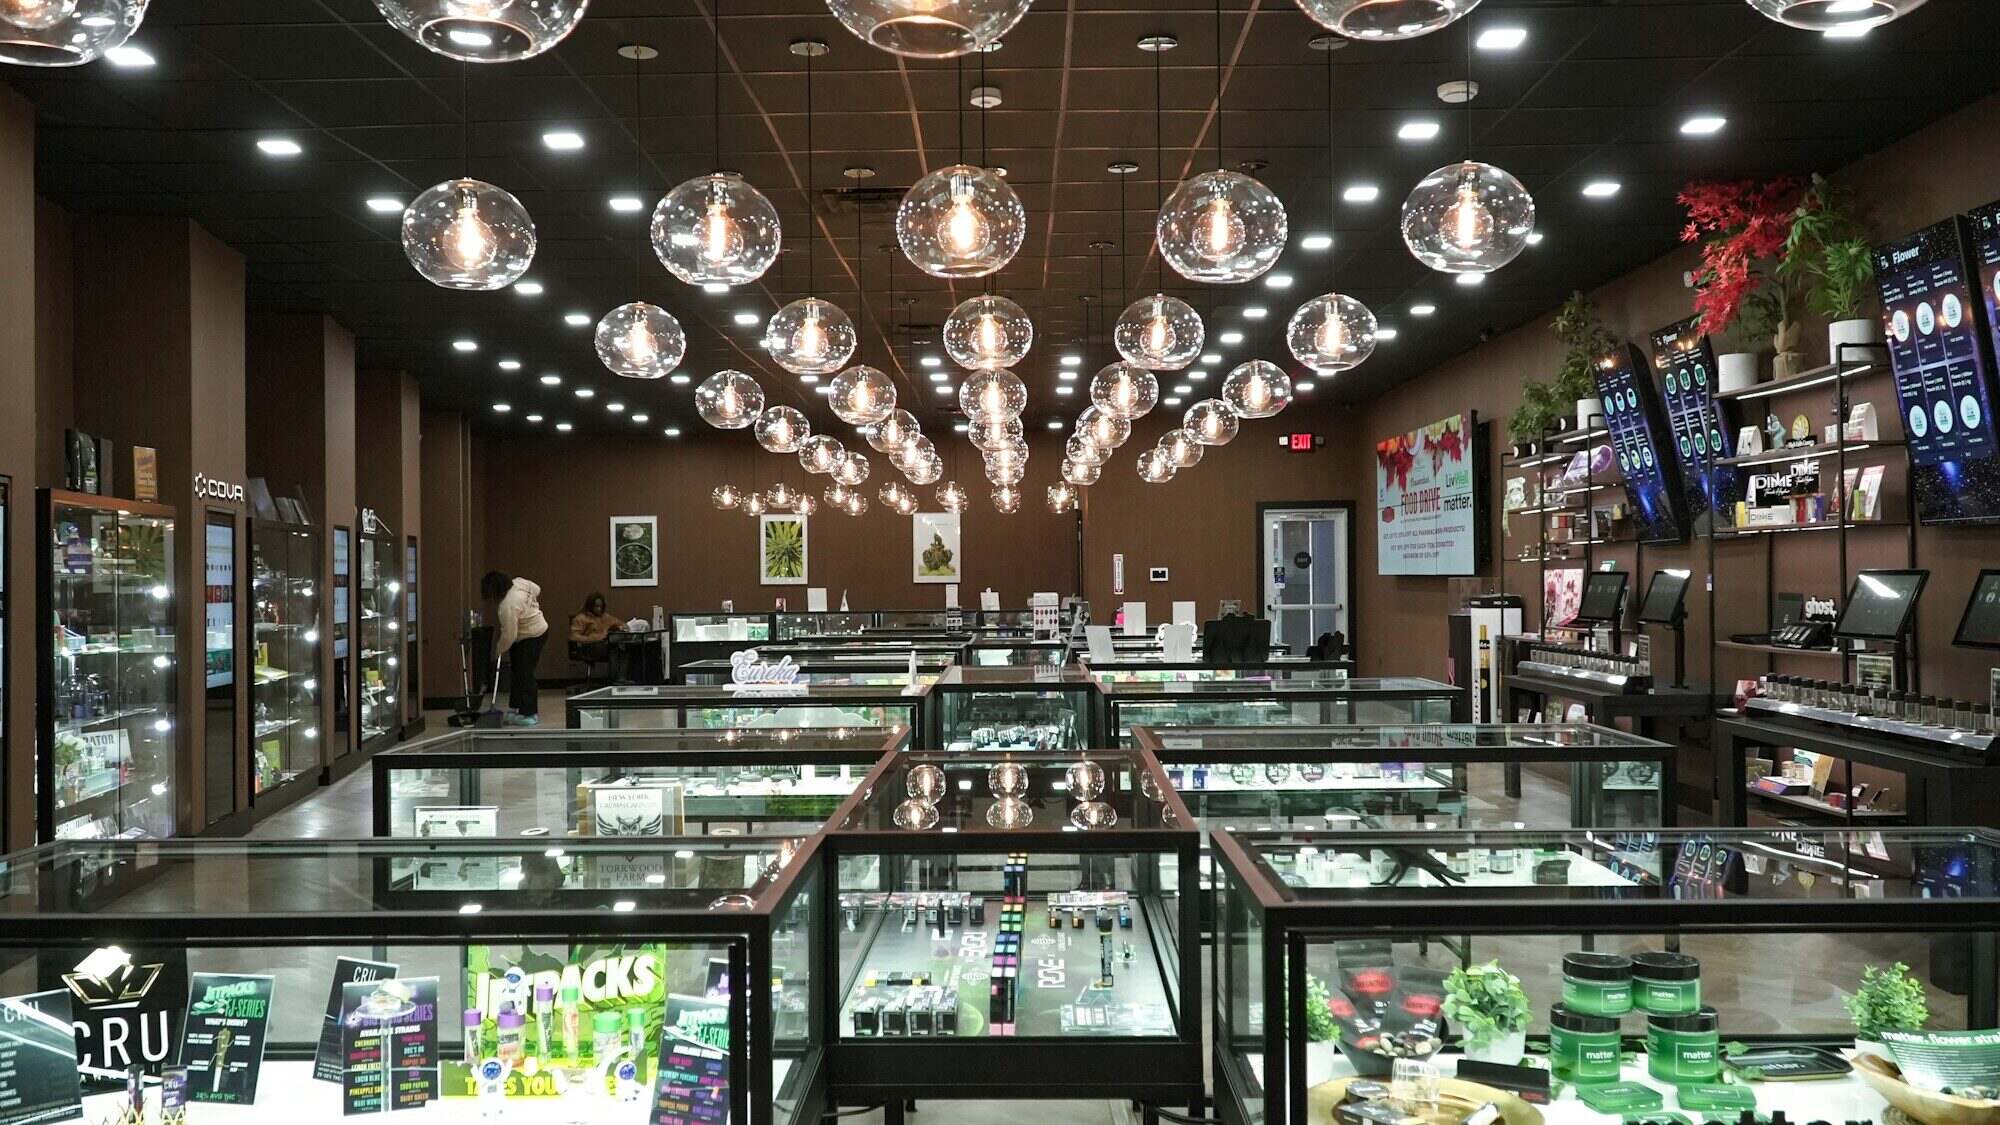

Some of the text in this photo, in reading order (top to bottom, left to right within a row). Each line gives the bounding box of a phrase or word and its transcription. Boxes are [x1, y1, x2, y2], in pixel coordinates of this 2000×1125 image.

[1892, 246, 1920, 264] Flower
[1291, 433, 1312, 450] EXIT
[1790, 456, 1819, 477] DIME
[1755, 472, 1793, 489] DIME
[208, 479, 245, 502] COVA
[1401, 487, 1441, 516] FOOD DRIVE
[1444, 494, 1473, 513] matter.
[730, 649, 800, 683] Eureka
[353, 966, 376, 982] CRU
[72, 1010, 169, 1070] CRU
[1881, 1031, 1928, 1042] matter.
[1928, 1033, 1971, 1045] flower
[1586, 1051, 1615, 1060] matter.
[1683, 1051, 1713, 1060] matter.
